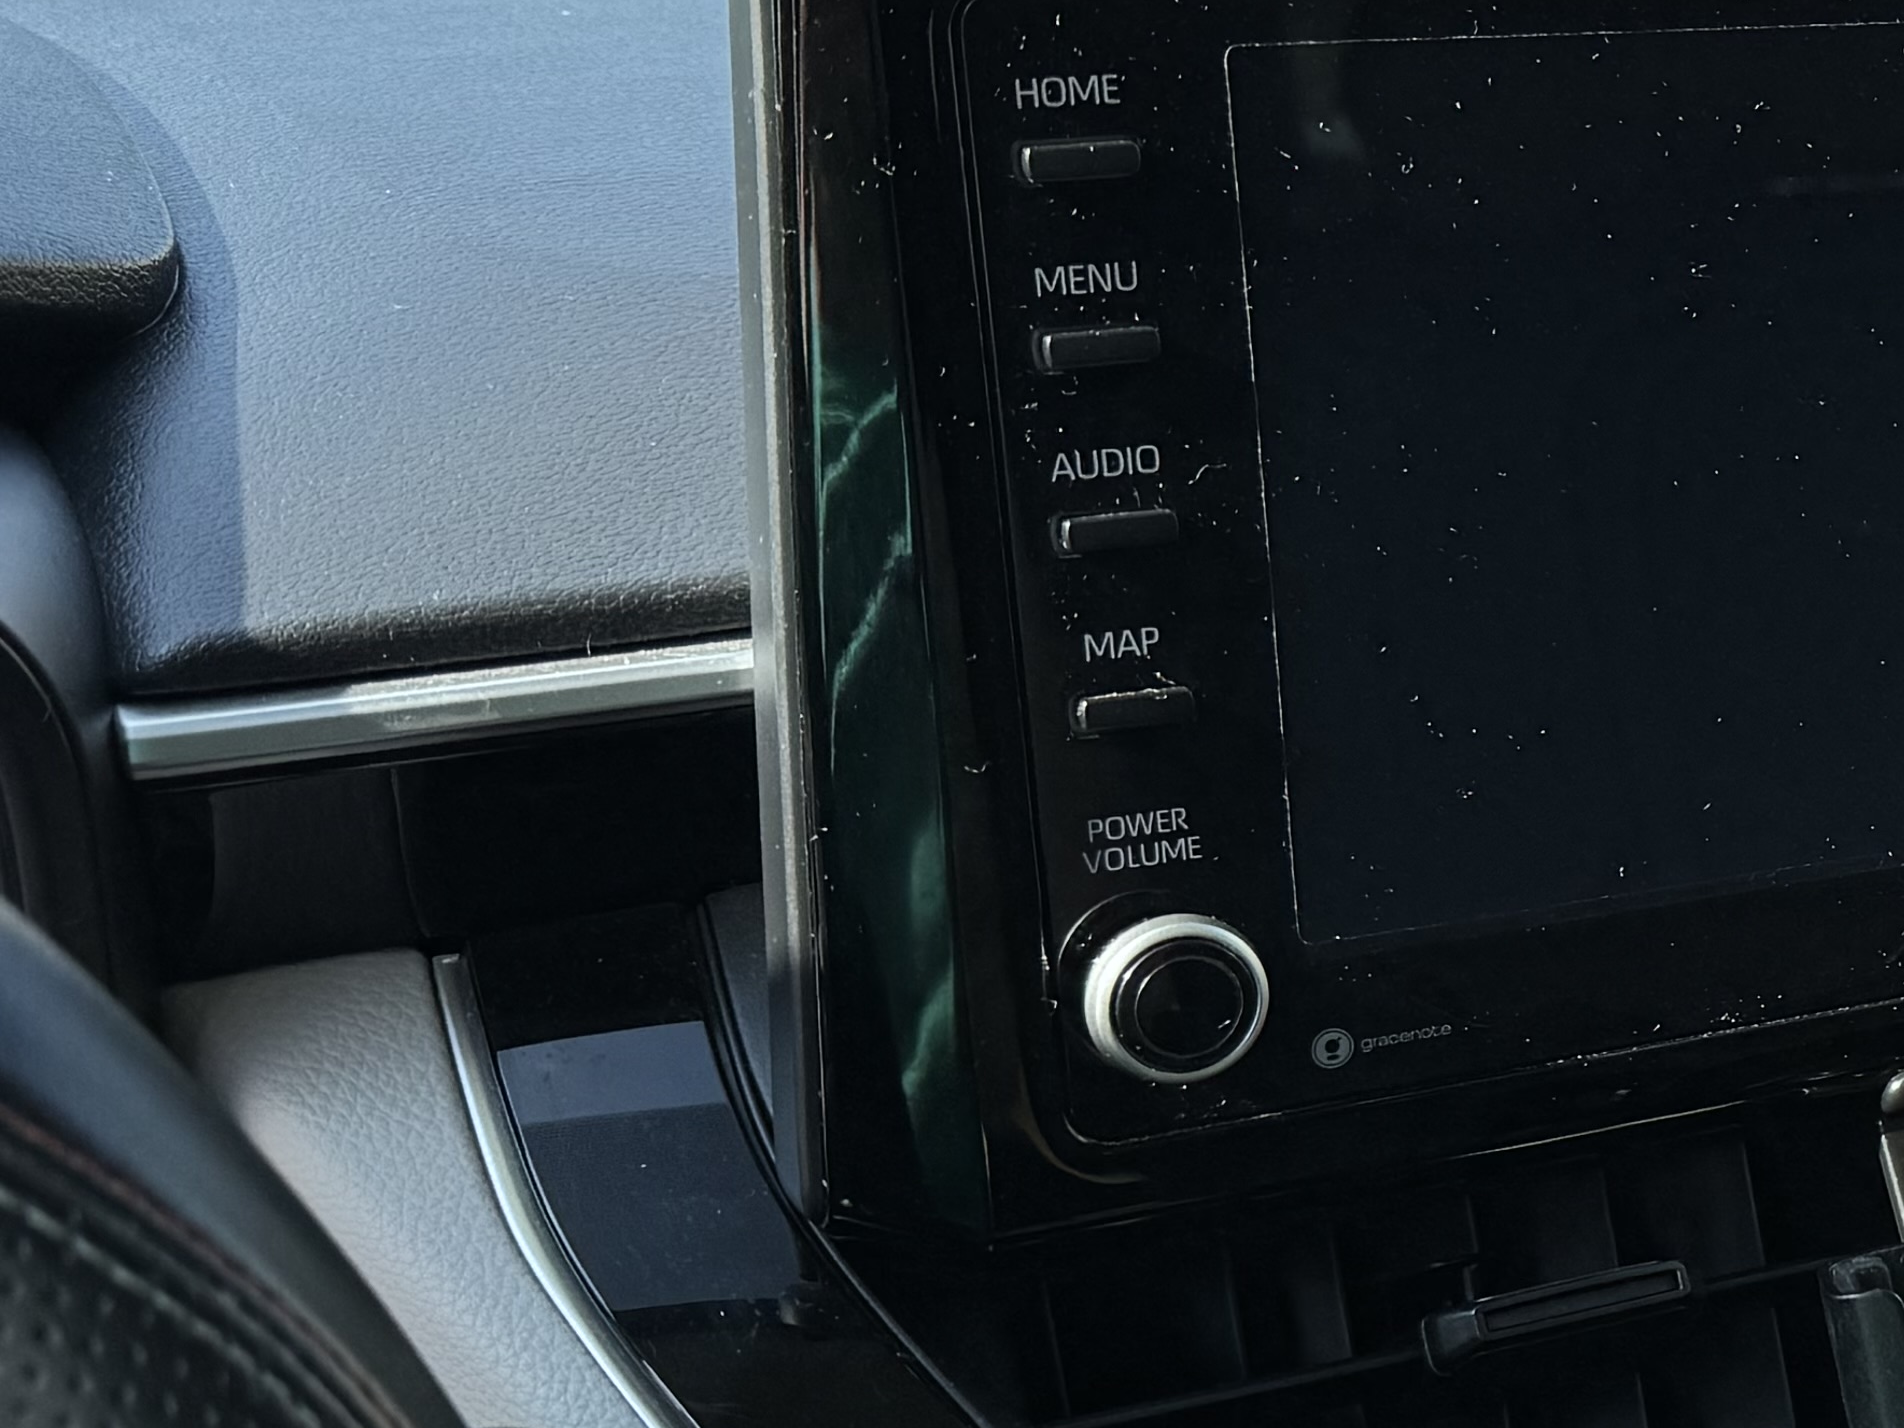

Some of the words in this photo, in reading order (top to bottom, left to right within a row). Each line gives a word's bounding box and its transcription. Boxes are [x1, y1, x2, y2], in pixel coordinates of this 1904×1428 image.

[1014, 73, 1121, 110] HOME
[1034, 261, 1139, 297] MENU
[1052, 445, 1160, 482] AUDIO
[1084, 627, 1160, 662] MAP
[1088, 807, 1188, 842] POWER
[1083, 837, 1202, 874] VOLUME
[1360, 1023, 1452, 1053] gracenote
